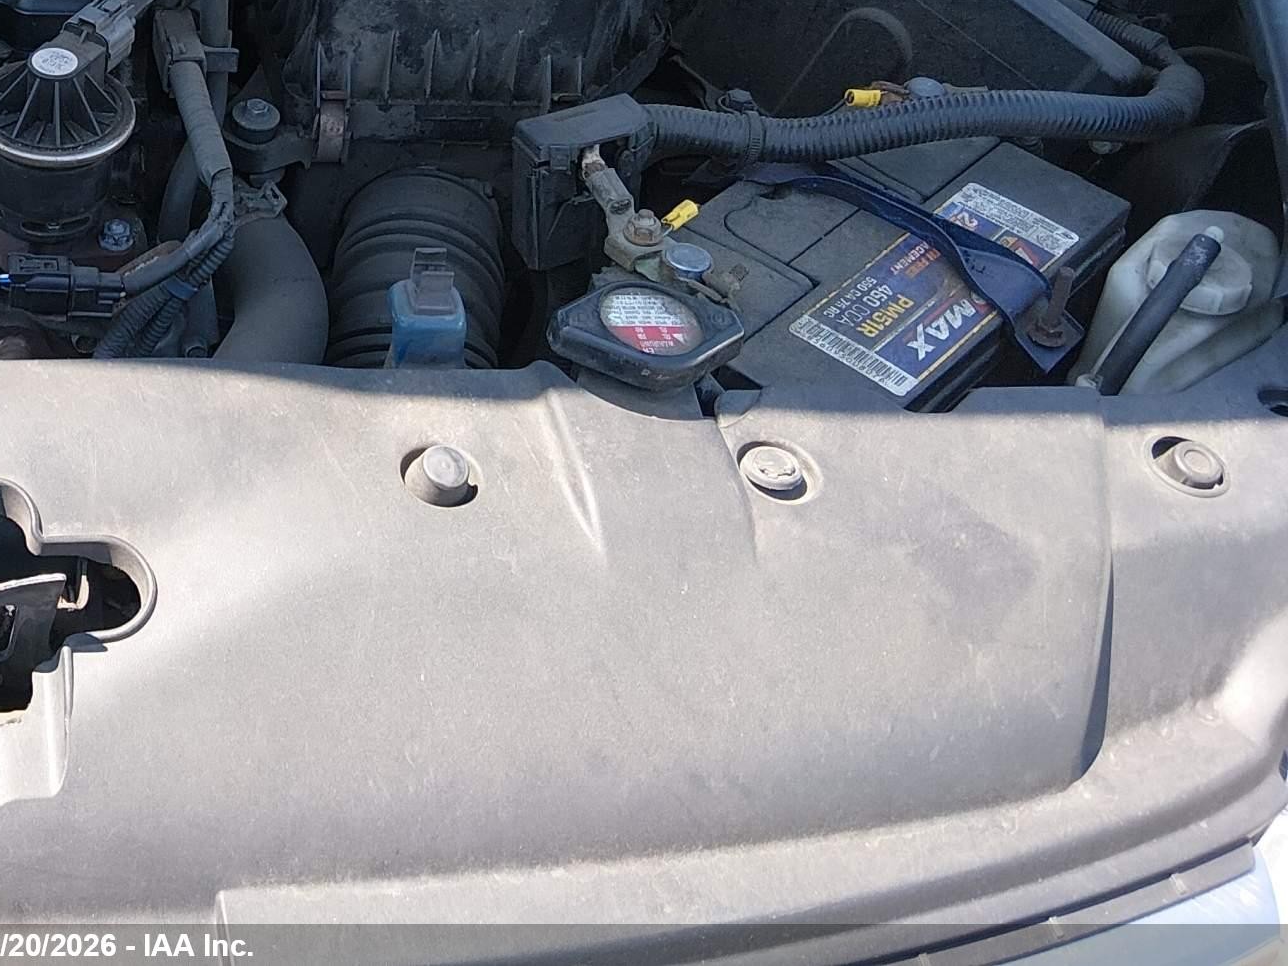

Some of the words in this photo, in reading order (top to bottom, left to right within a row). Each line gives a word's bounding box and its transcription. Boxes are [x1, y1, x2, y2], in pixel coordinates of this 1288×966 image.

[889, 240, 930, 275] ACEMENT
[863, 284, 893, 308] 460
[836, 302, 873, 327] CCA
[856, 294, 915, 338] PM51R
[907, 296, 978, 361] MAX
